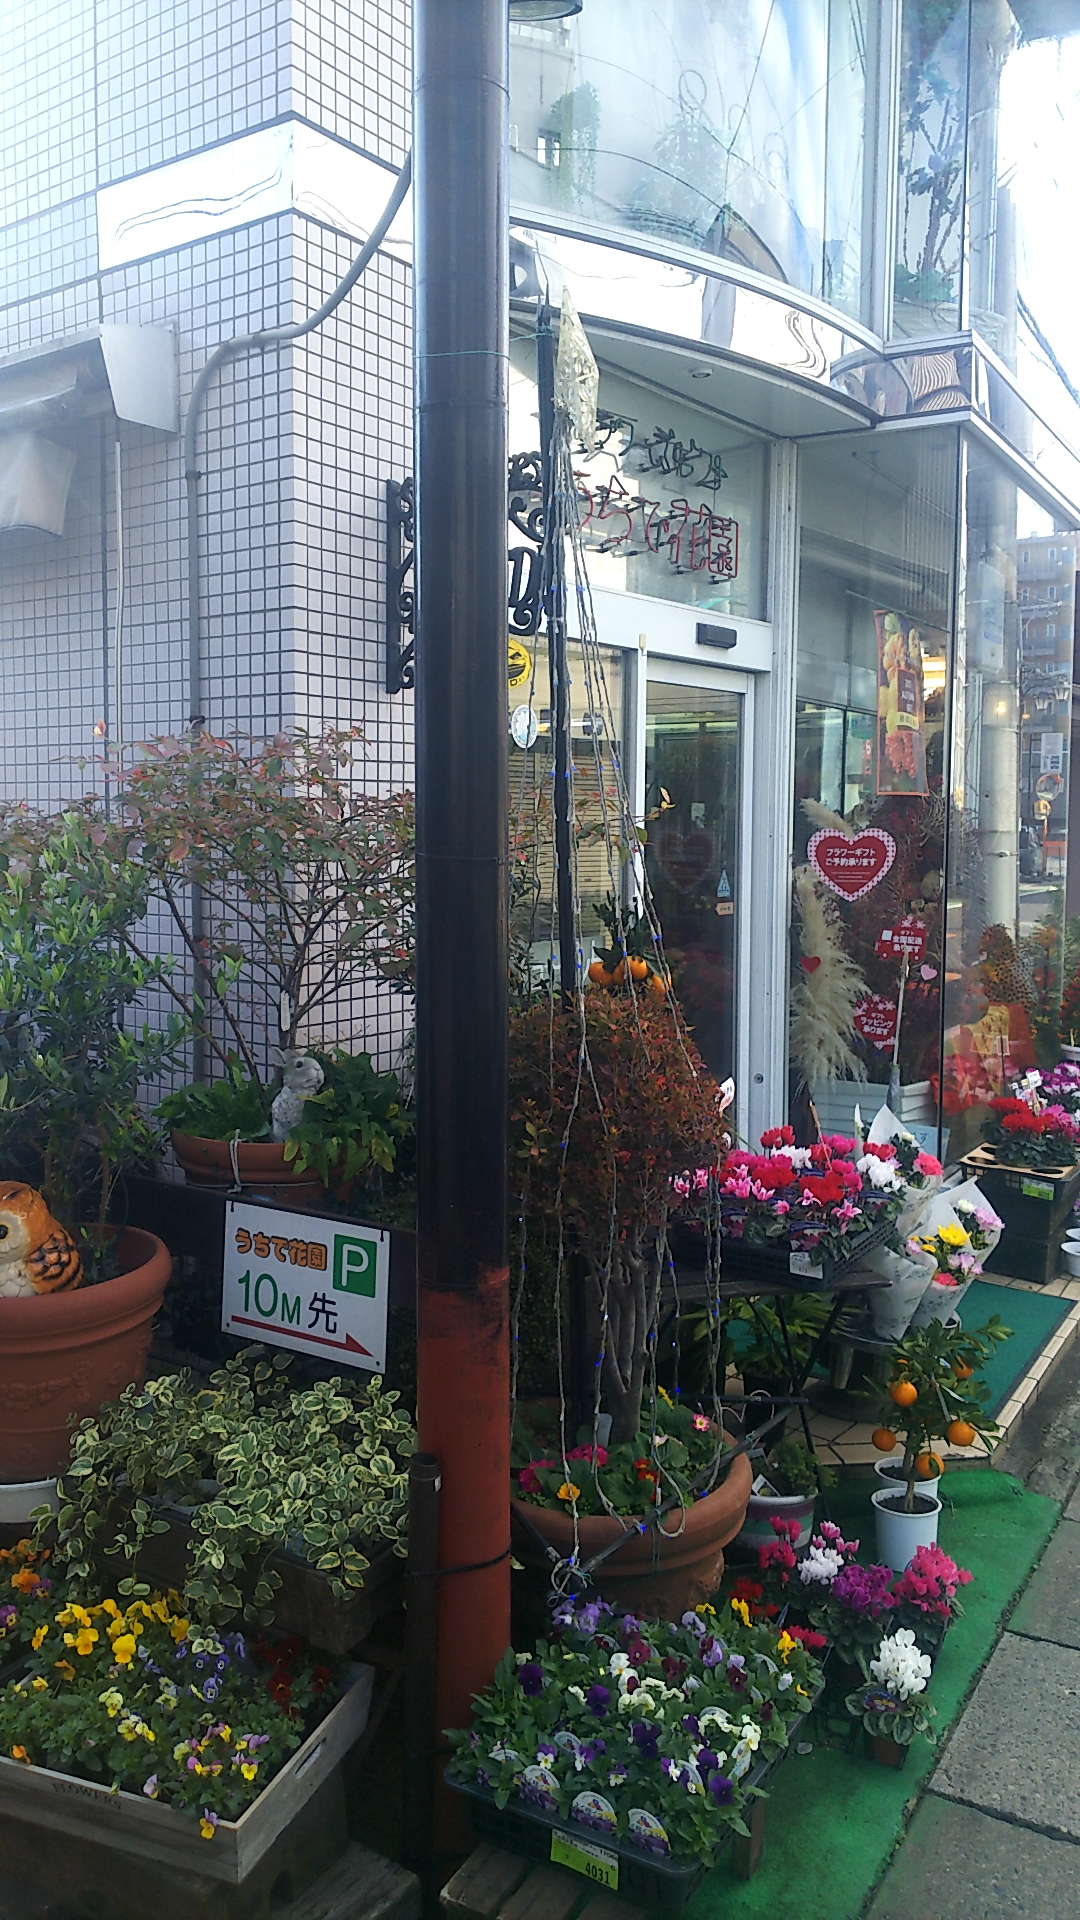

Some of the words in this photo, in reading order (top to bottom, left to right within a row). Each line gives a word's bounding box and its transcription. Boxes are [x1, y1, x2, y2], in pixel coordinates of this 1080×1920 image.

[825, 857, 877, 867] ご予約承ります
[826, 847, 876, 857] フラワーギフト
[860, 1016, 894, 1029] ラッピング
[235, 1227, 328, 1272] うちで花園
[341, 1243, 369, 1287] P
[52, 1782, 122, 1811] FLOWERS
[585, 1862, 610, 1884] 4031
